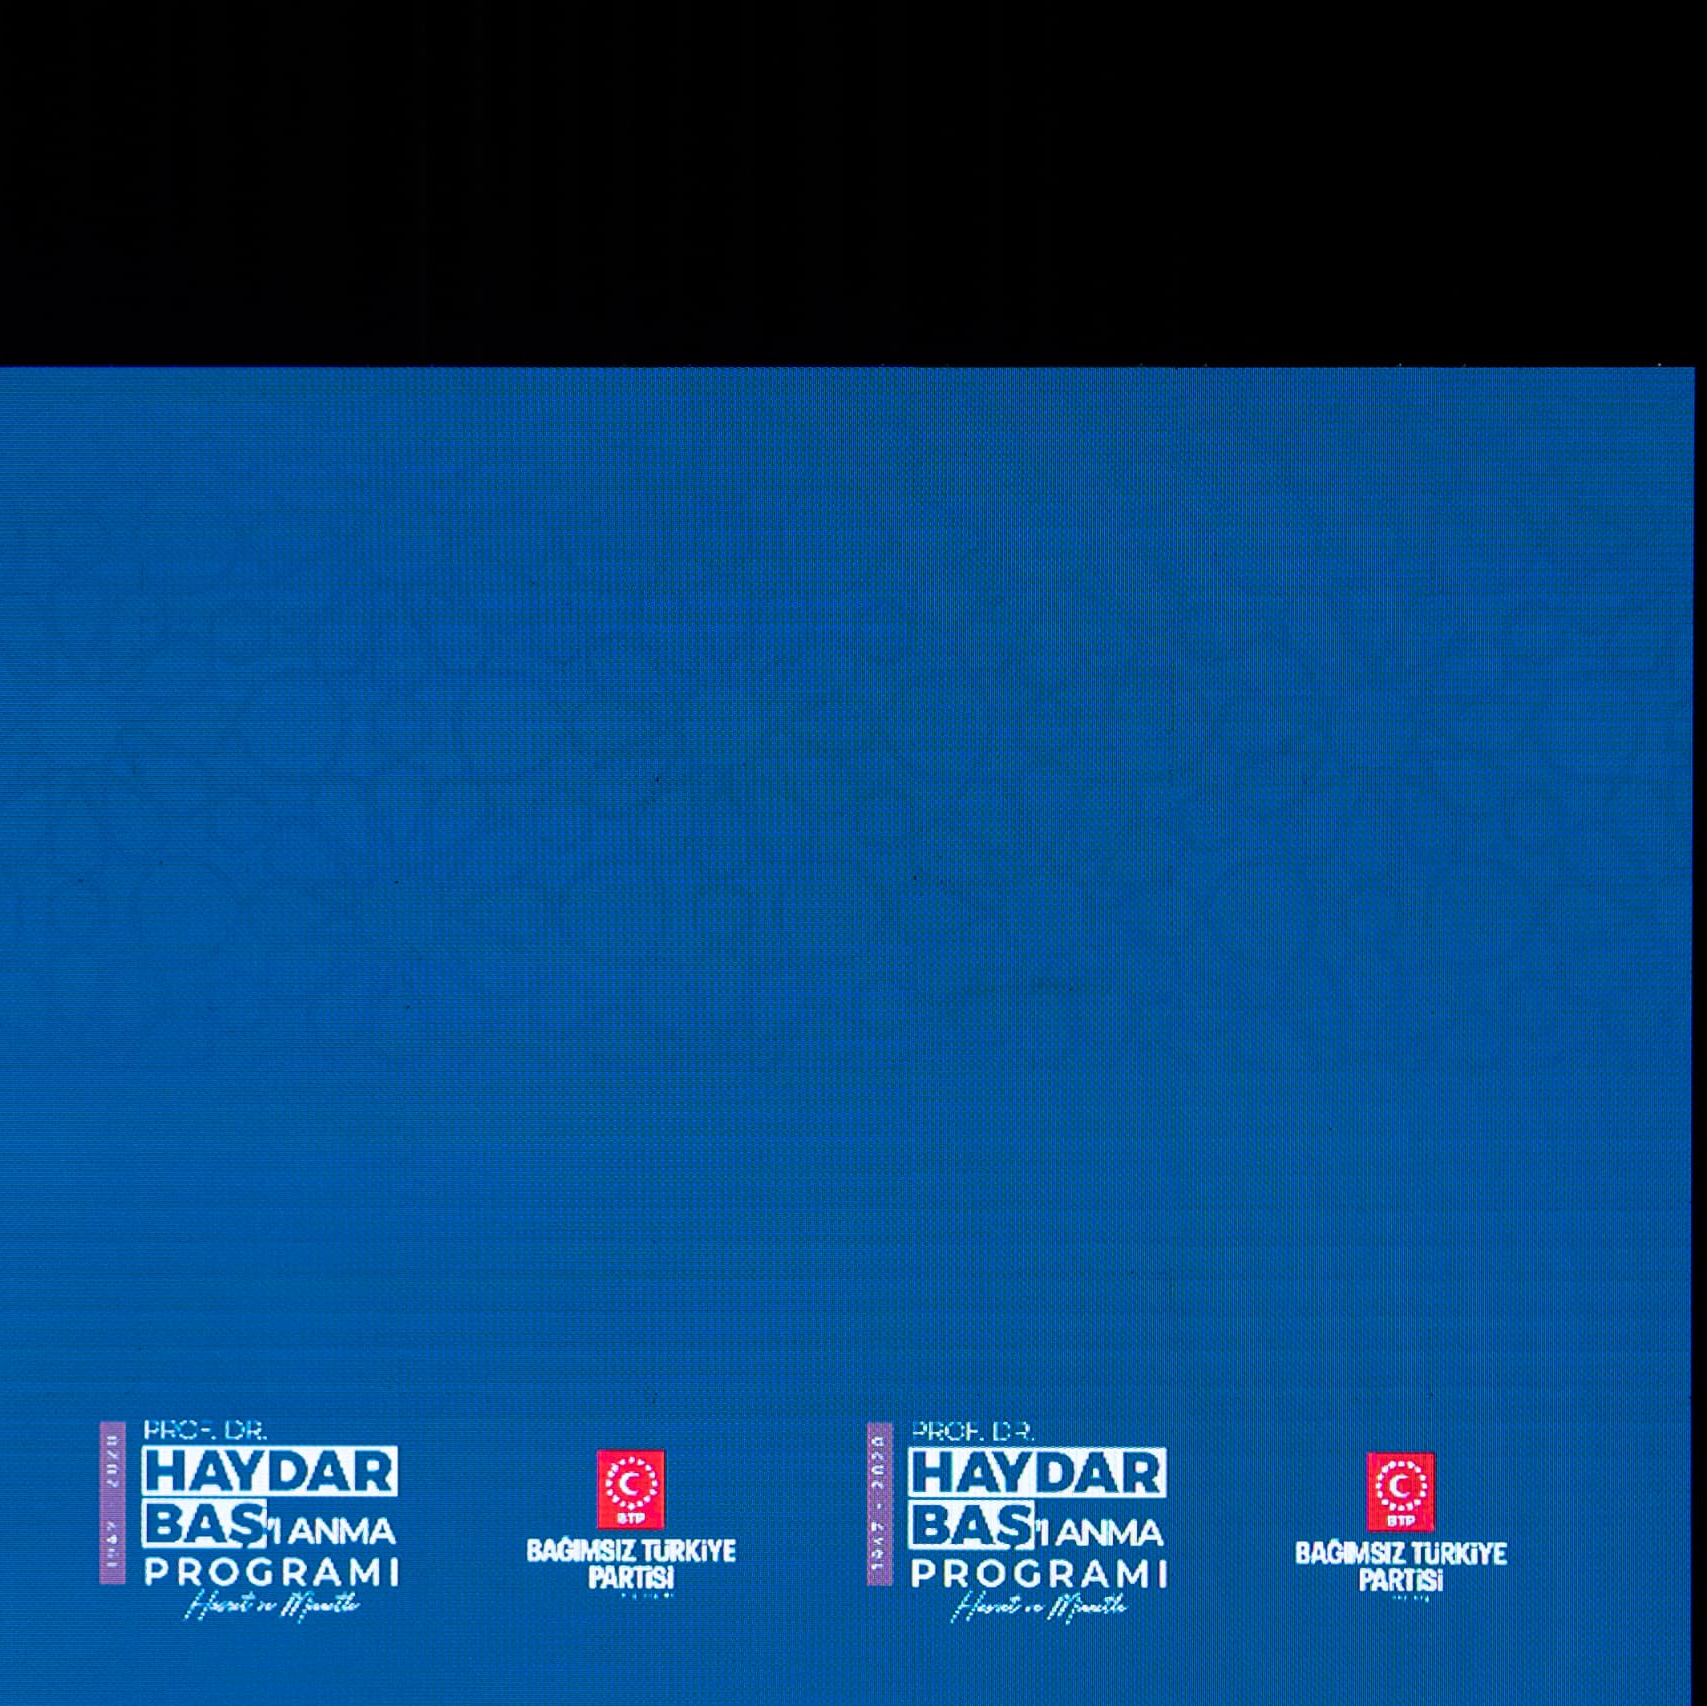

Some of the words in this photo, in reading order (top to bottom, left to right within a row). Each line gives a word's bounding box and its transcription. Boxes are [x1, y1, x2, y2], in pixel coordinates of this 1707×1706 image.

[147, 1451, 392, 1491] HAYDAR
[914, 1452, 1160, 1493] HAYDAR
[288, 1518, 396, 1544] ANMA
[1056, 1520, 1163, 1546] ANMA
[146, 1558, 398, 1586] PROGRAMI
[912, 1559, 1166, 1588] PROGRAMI
